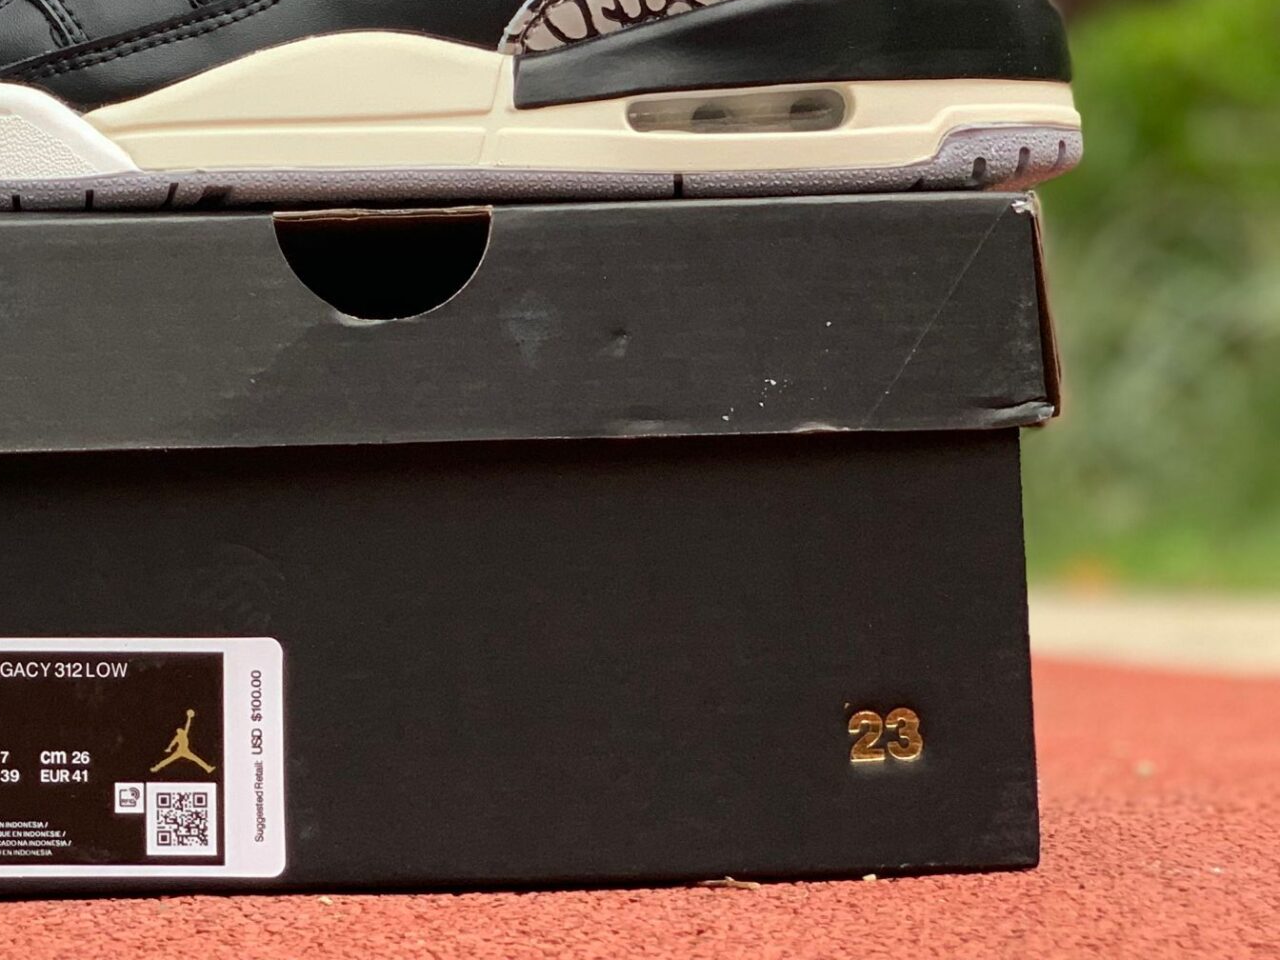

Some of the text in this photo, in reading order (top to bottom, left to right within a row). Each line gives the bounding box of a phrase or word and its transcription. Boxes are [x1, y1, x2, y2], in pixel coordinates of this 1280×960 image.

[54, 661, 83, 678] 312
[86, 661, 128, 678] LOW
[250, 670, 263, 722] $100.00
[251, 728, 263, 755] USD
[848, 707, 924, 763] 23
[0, 750, 10, 764] 7
[71, 750, 90, 764] 26
[0, 769, 20, 783] 39
[40, 769, 89, 783] EUR 41
[254, 791, 266, 842] Suggested
